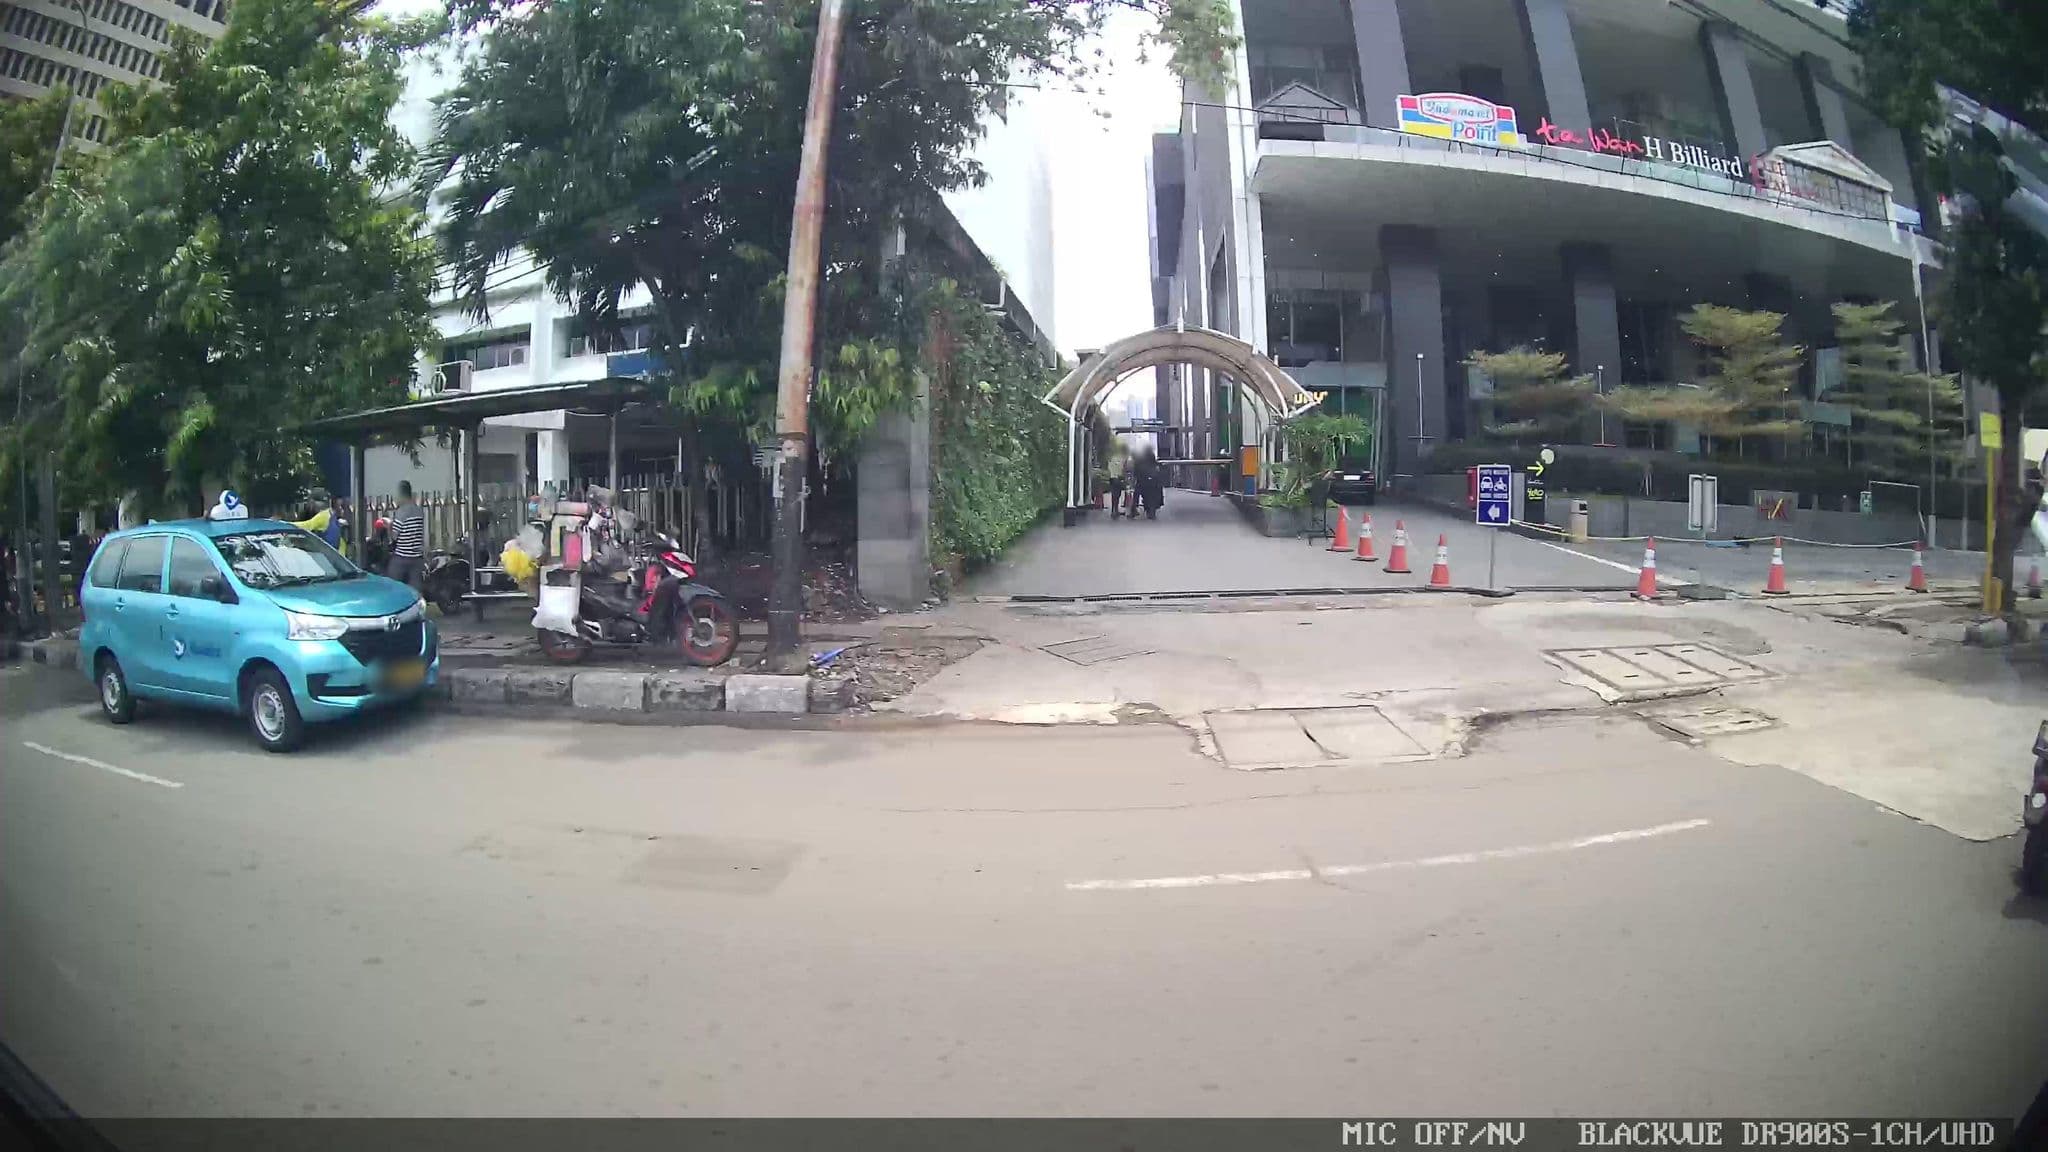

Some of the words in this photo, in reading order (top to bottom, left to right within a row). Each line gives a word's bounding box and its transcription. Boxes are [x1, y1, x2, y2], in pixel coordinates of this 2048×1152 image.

[1453, 121, 1497, 142] Point
[1643, 135, 1665, 159] H
[1668, 140, 1744, 178] Billiard
